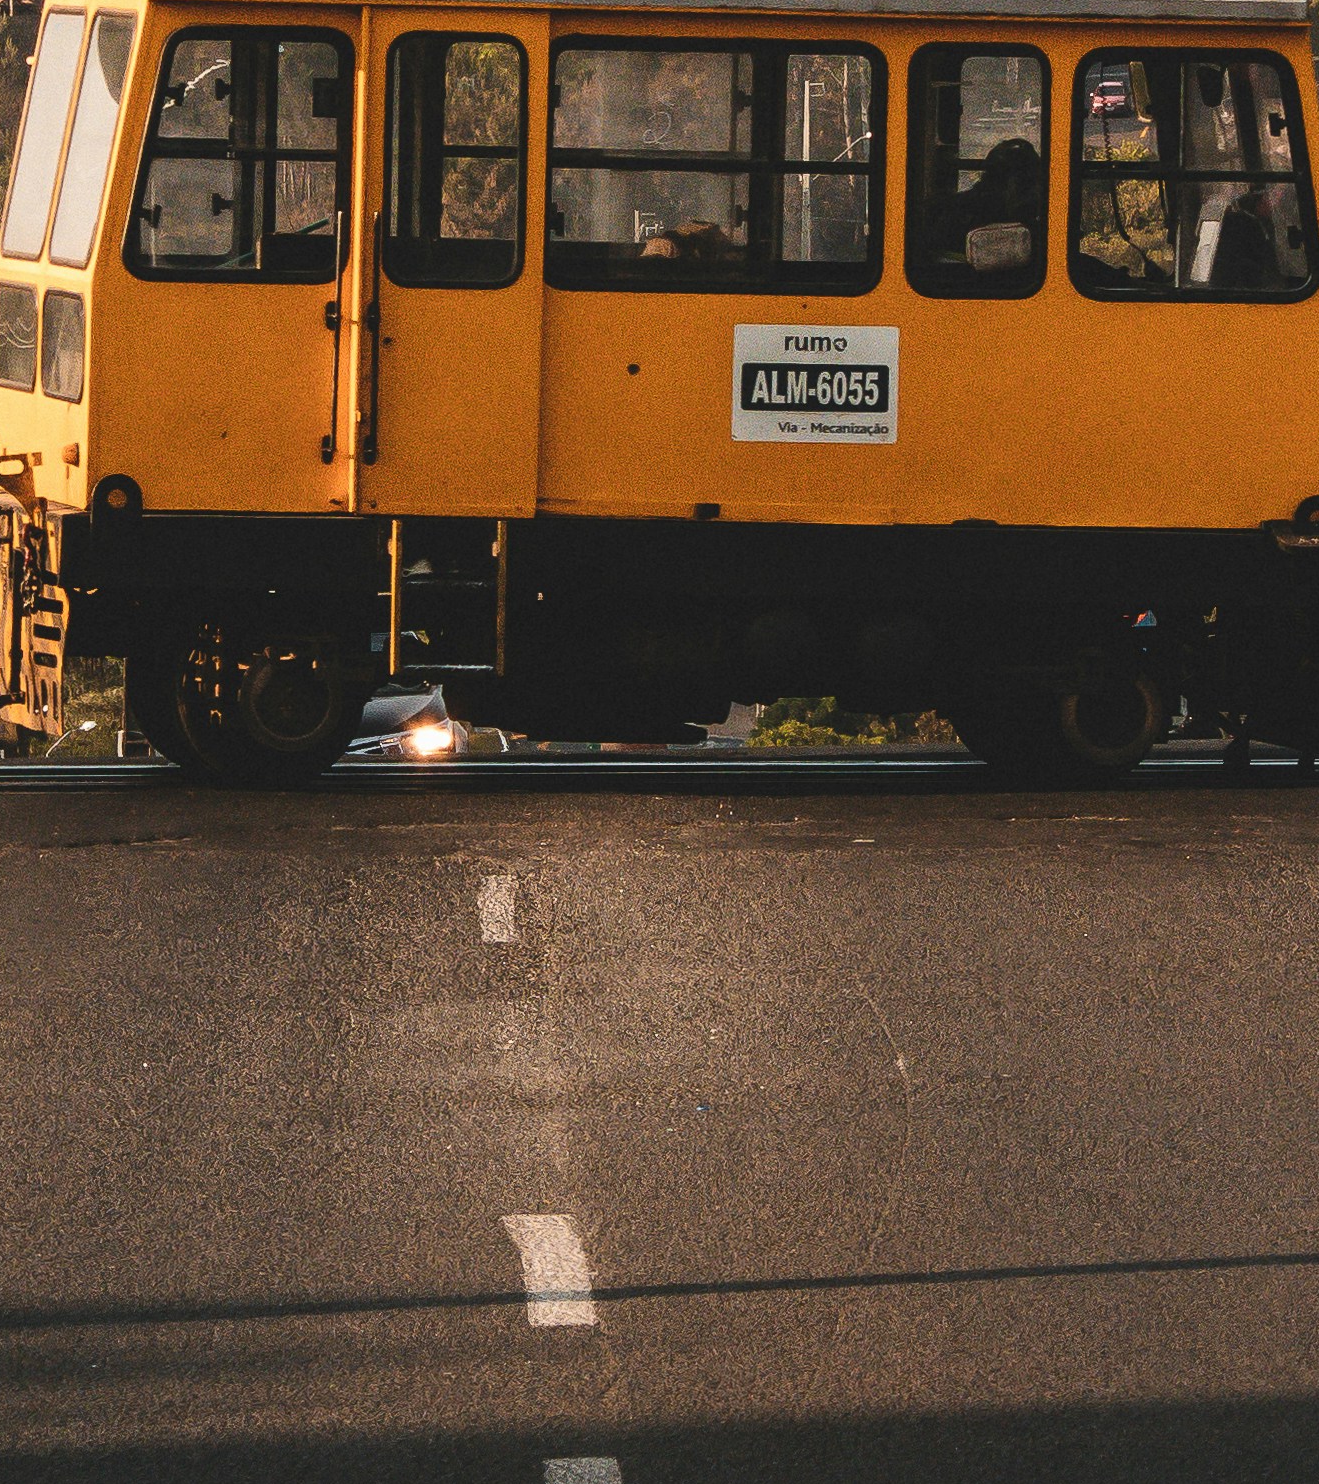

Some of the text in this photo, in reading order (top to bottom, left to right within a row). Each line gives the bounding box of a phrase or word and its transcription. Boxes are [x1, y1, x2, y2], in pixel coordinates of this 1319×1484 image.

[784, 335, 848, 352] rumo
[750, 370, 879, 406] ALM-6055
[778, 421, 798, 433] Via
[810, 421, 889, 436] Mecanização
